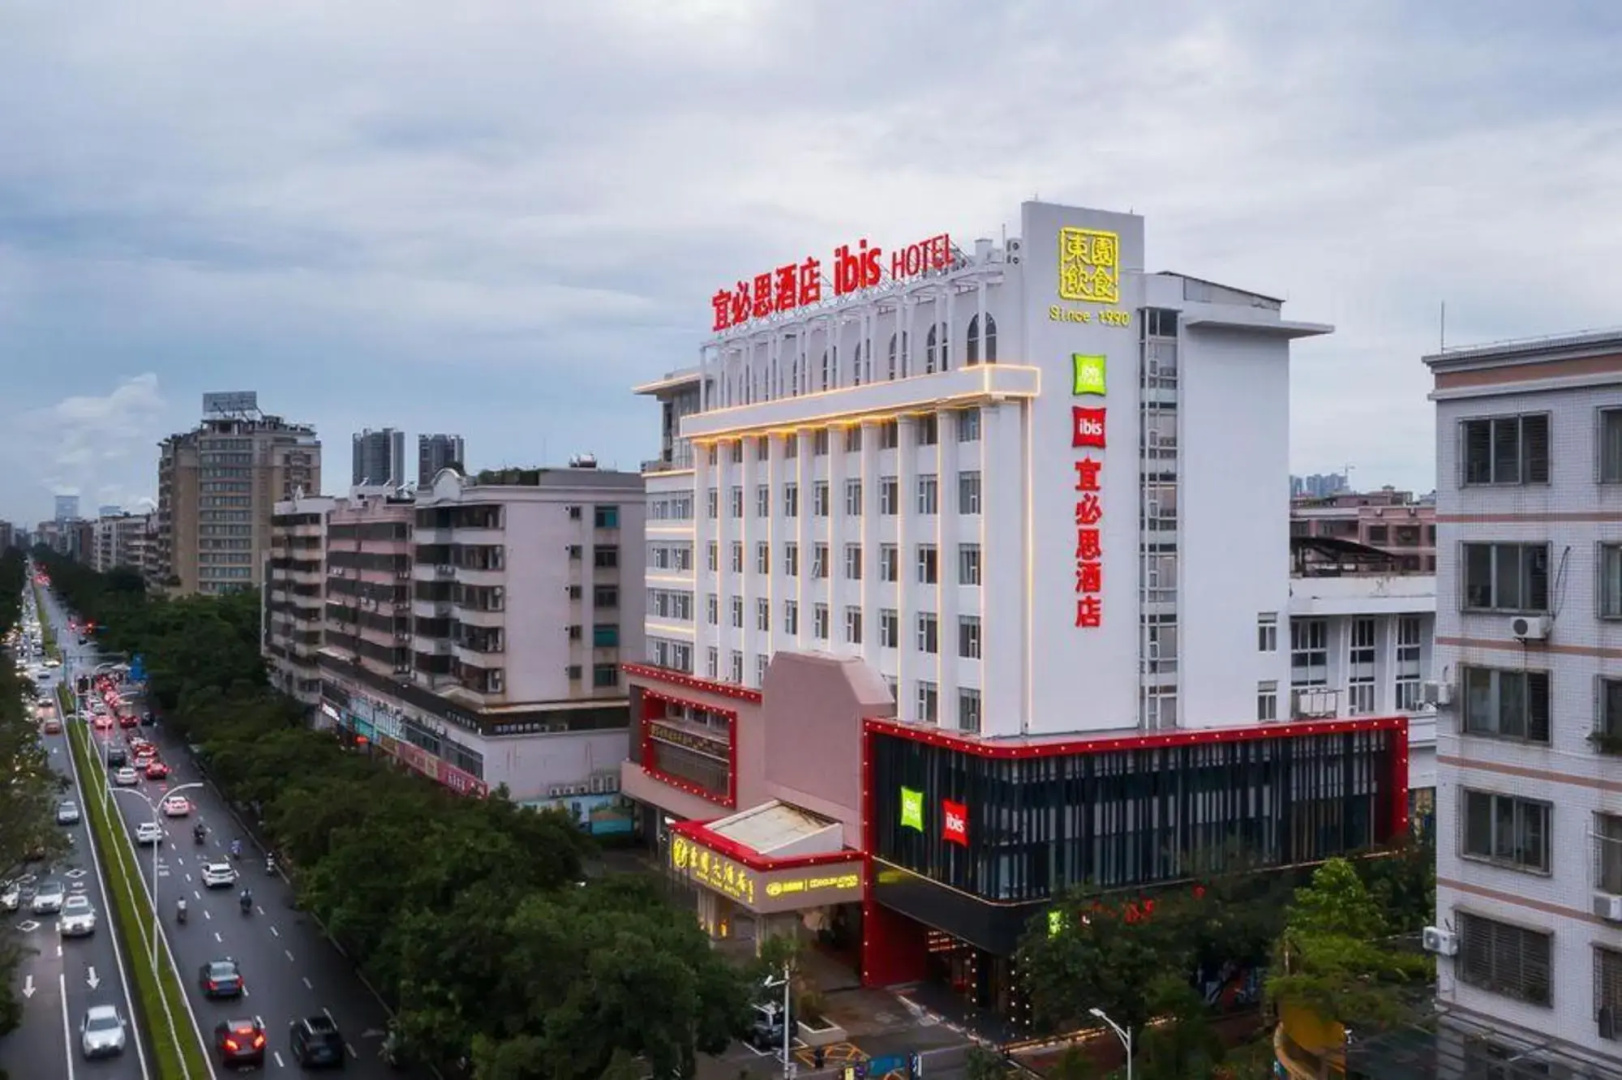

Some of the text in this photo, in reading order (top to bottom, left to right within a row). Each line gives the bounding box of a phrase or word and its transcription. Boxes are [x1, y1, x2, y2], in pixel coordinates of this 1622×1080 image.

[712, 233, 955, 332] 宜必思酒店 ibis HOTEL
[1049, 304, 1130, 327] Since 1990
[1079, 418, 1103, 435] ibis
[1075, 457, 1102, 628] 宜必思酒店
[945, 811, 965, 834] ibis
